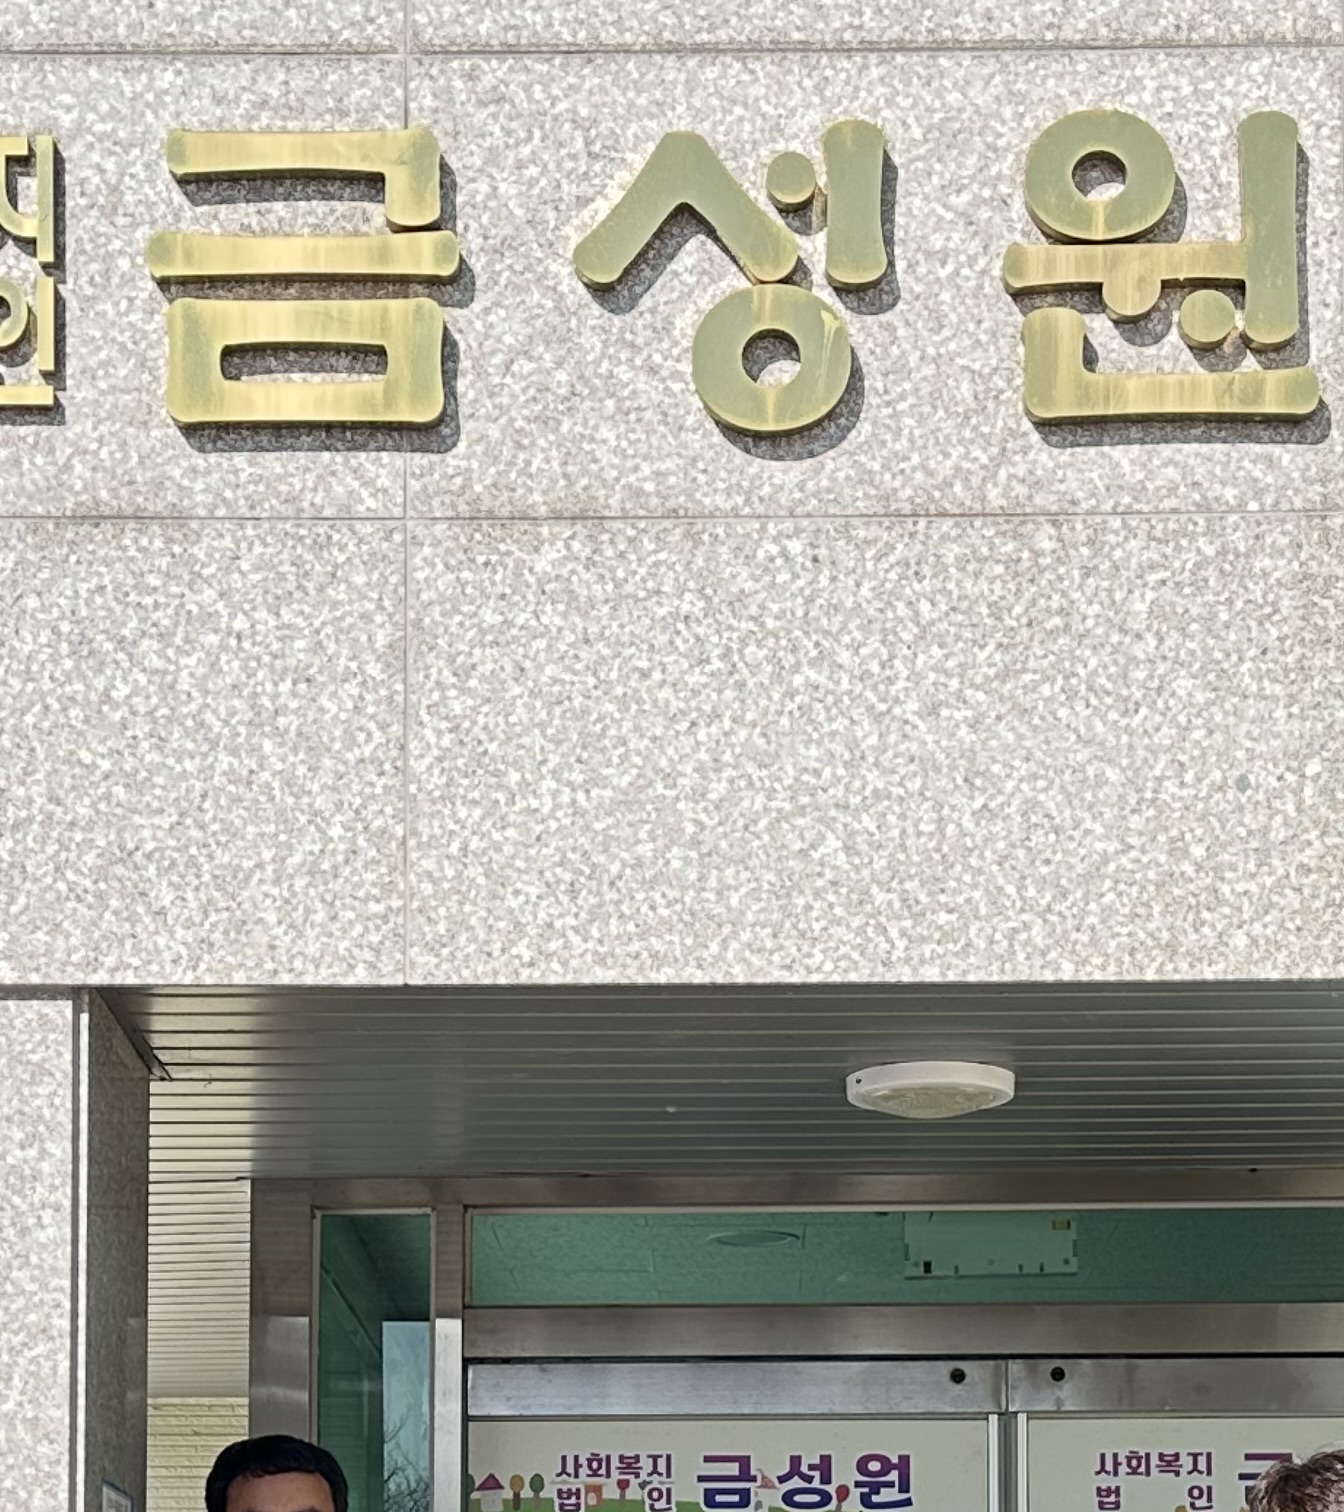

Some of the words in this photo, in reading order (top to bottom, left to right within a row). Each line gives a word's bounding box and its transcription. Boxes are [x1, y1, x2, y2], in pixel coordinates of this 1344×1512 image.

[555, 1452, 673, 1480] 사회복지
[1094, 1450, 1214, 1478] 사회복지
[697, 1453, 914, 1511] 금성원
